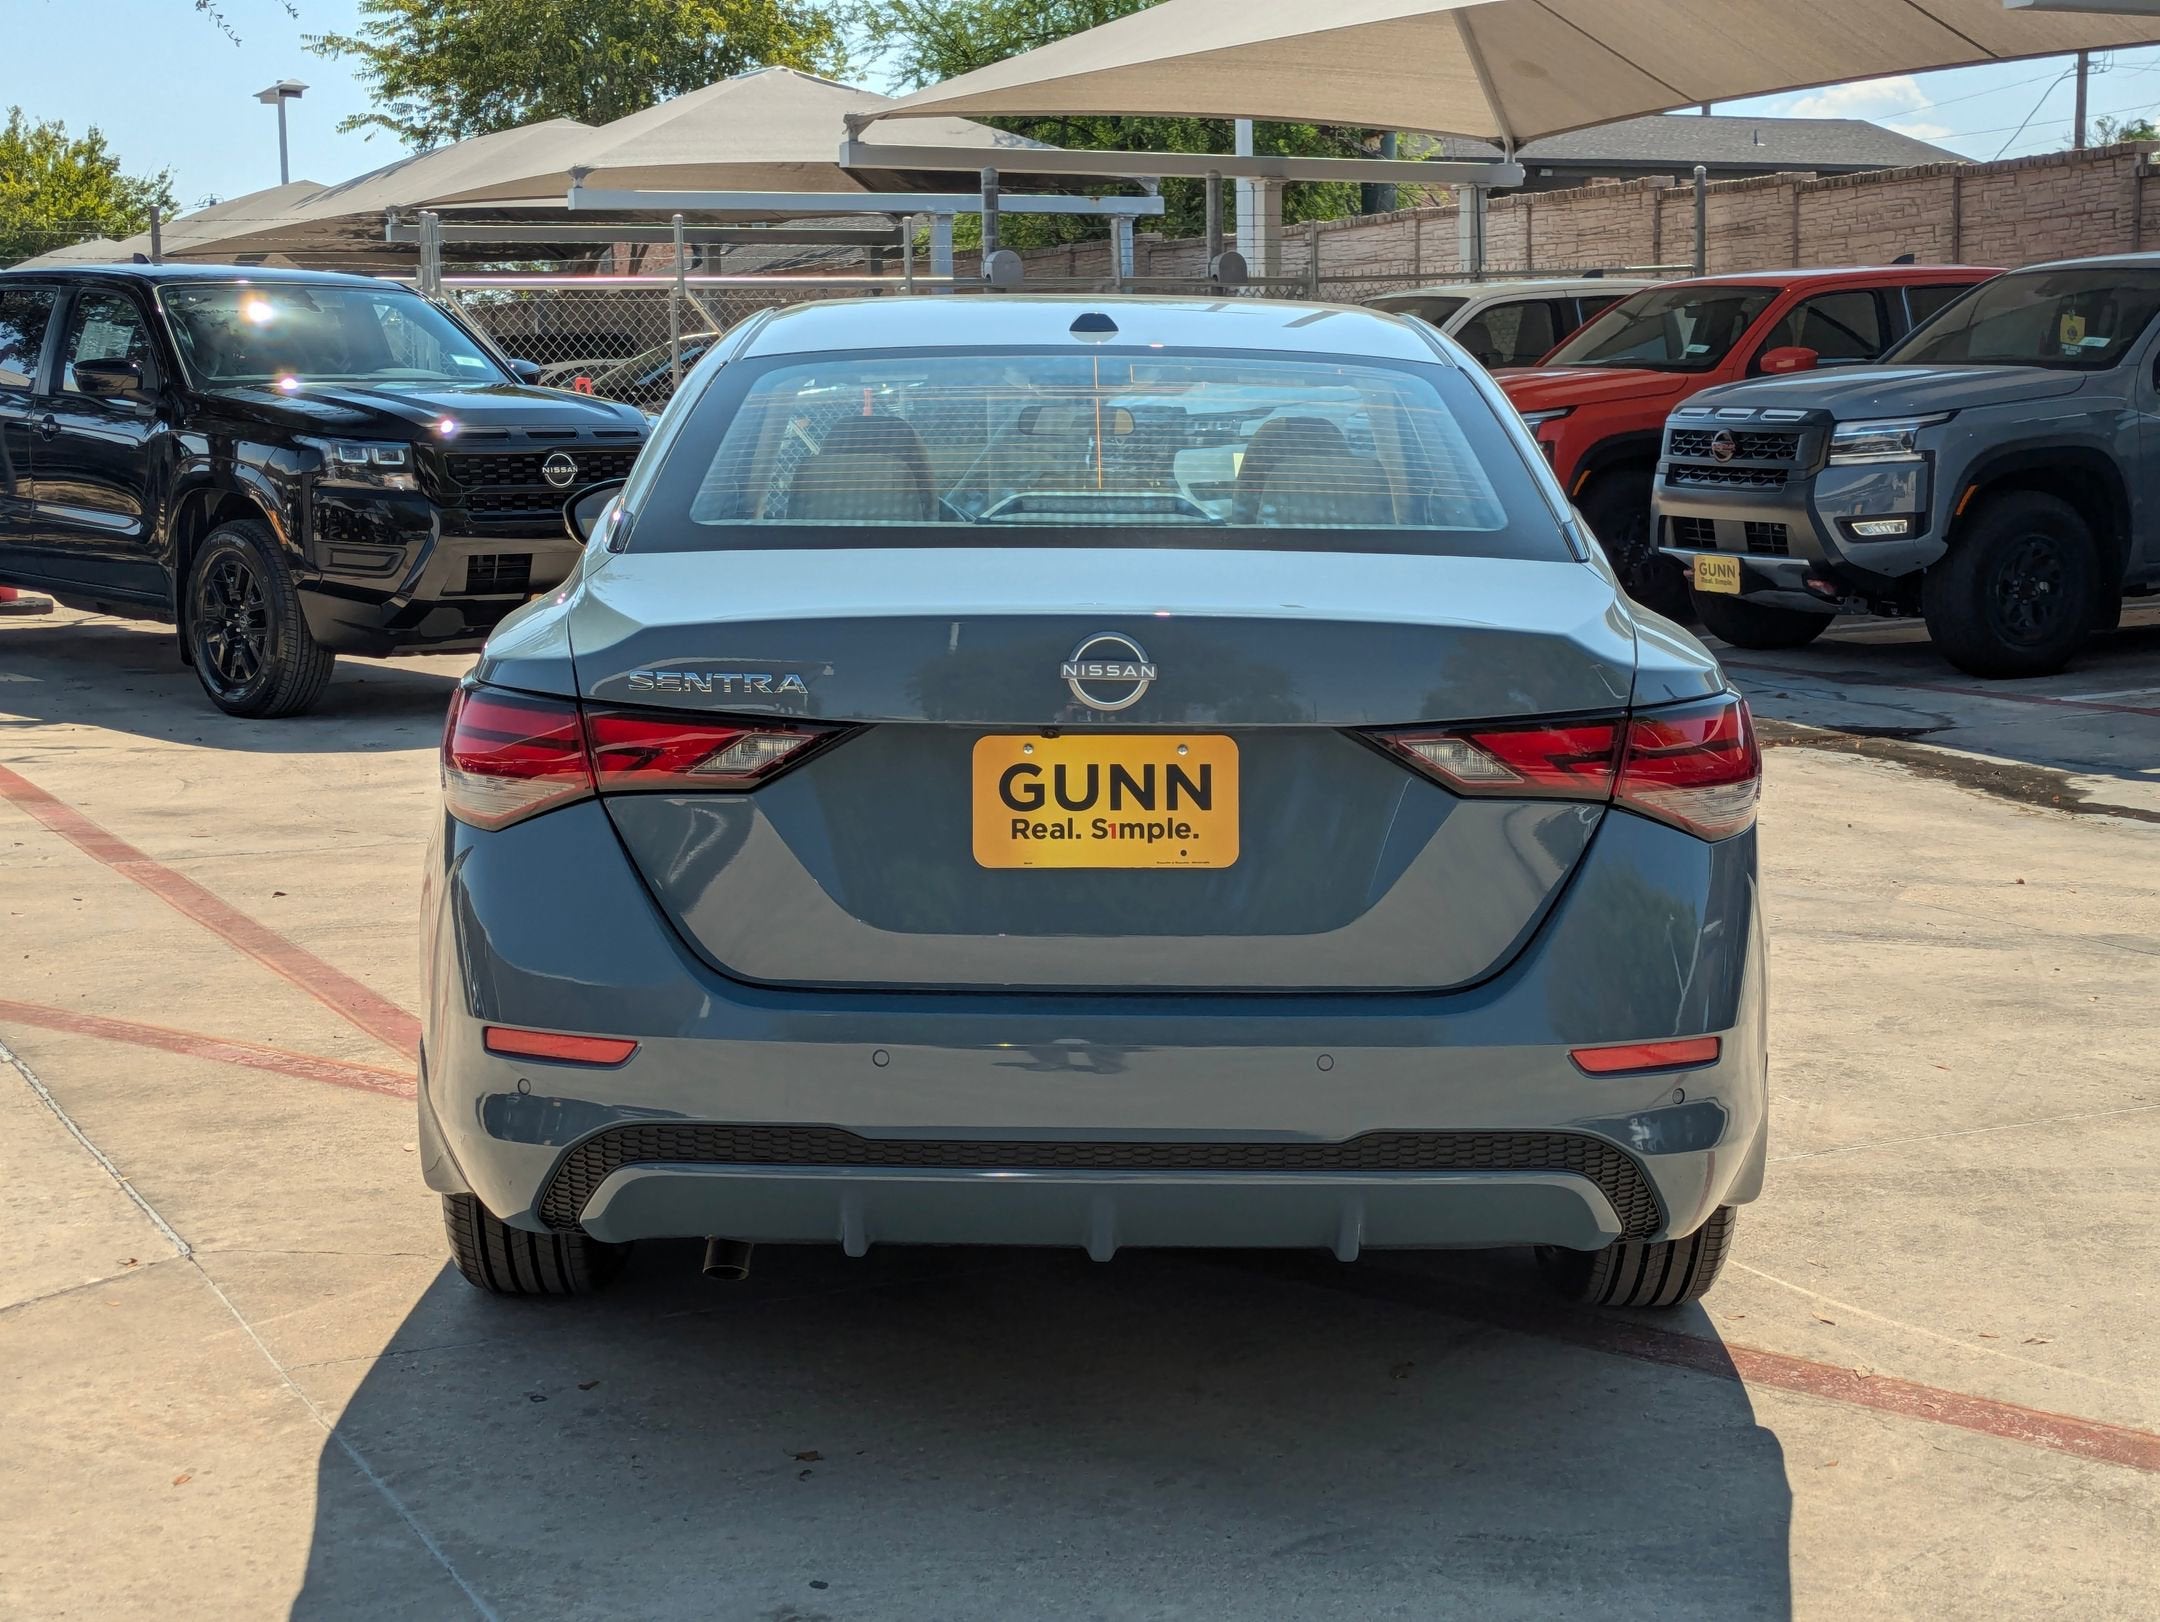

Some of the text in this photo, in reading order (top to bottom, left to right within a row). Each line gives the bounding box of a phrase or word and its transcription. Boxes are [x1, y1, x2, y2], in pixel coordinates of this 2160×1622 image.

[542, 466, 578, 474] NISSAN
[1699, 562, 1736, 578] GUNN
[1063, 664, 1155, 678] NISSAN
[628, 670, 809, 694] SENTRA
[999, 763, 1212, 812] GUNN
[1011, 817, 1082, 840] Real.
